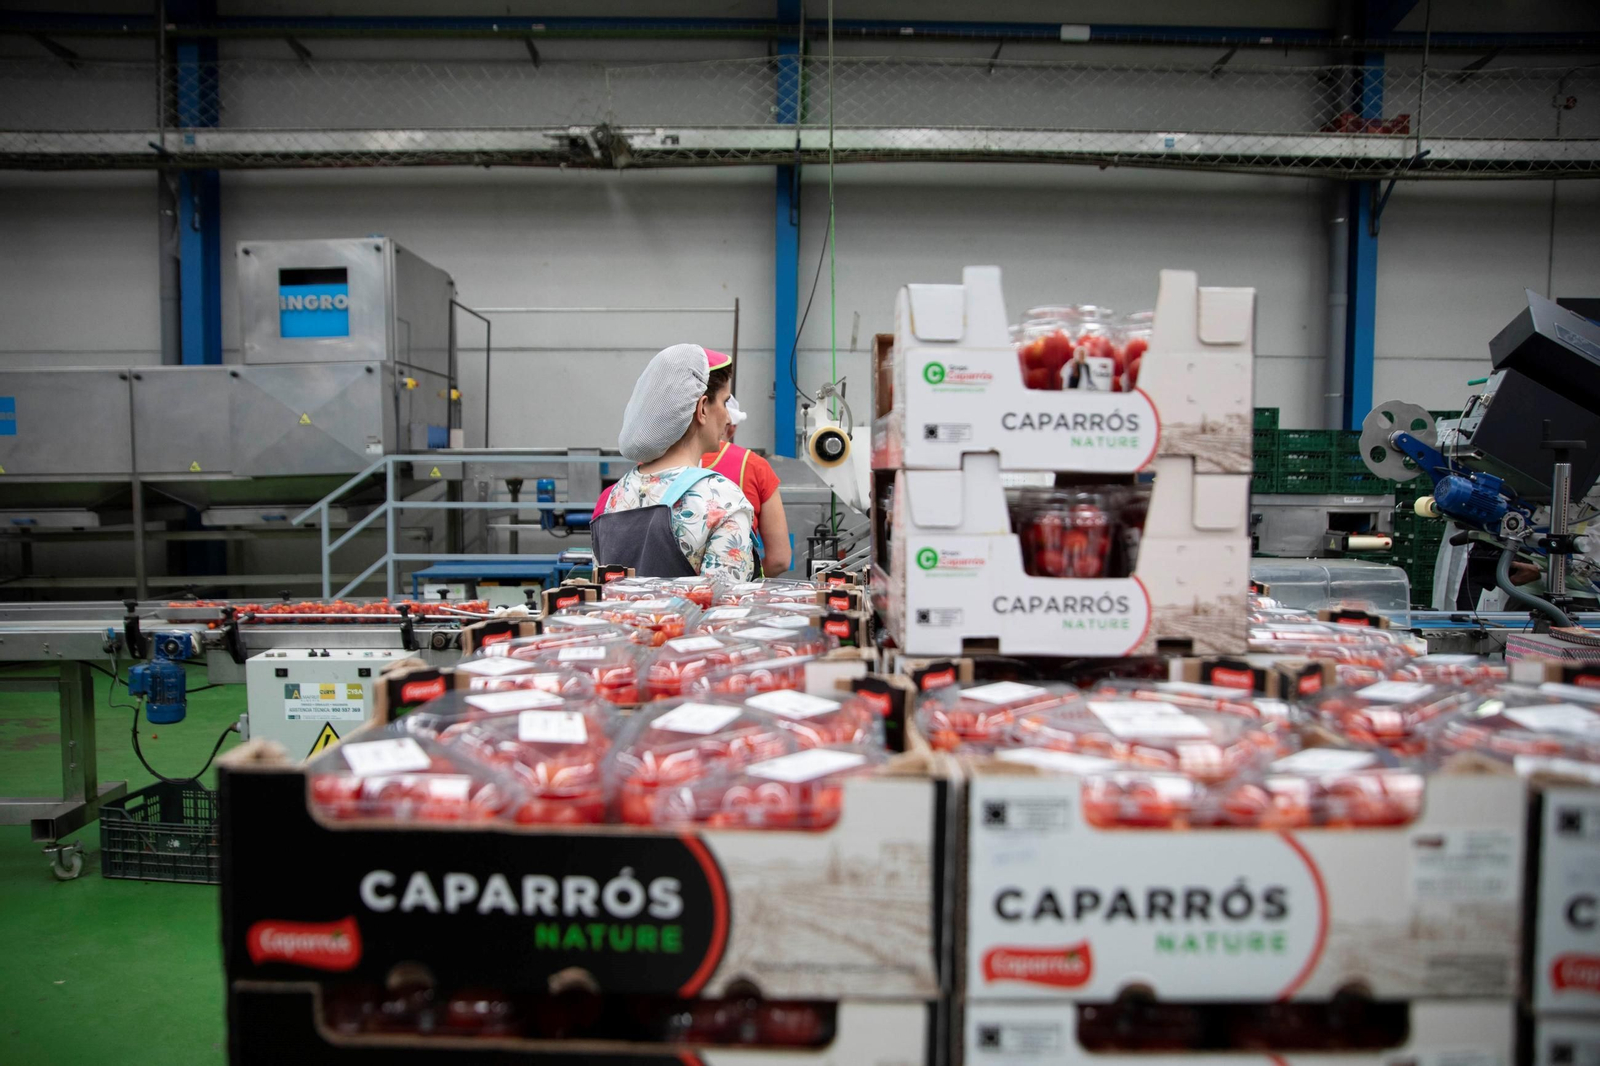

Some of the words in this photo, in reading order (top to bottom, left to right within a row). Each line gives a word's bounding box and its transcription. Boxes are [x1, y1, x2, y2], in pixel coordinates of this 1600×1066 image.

[280, 294, 348, 311] INGRO
[1001, 408, 1140, 432] CAPARRÓS
[1070, 436, 1140, 448] NATURE
[992, 591, 1131, 615] CAPARRÓS
[1062, 618, 1131, 630] NATURE
[360, 866, 684, 919] CAPARRÓS
[993, 875, 1290, 922] CAPARRÓS
[534, 923, 684, 953] NATURE
[1154, 929, 1290, 956] NATURE
